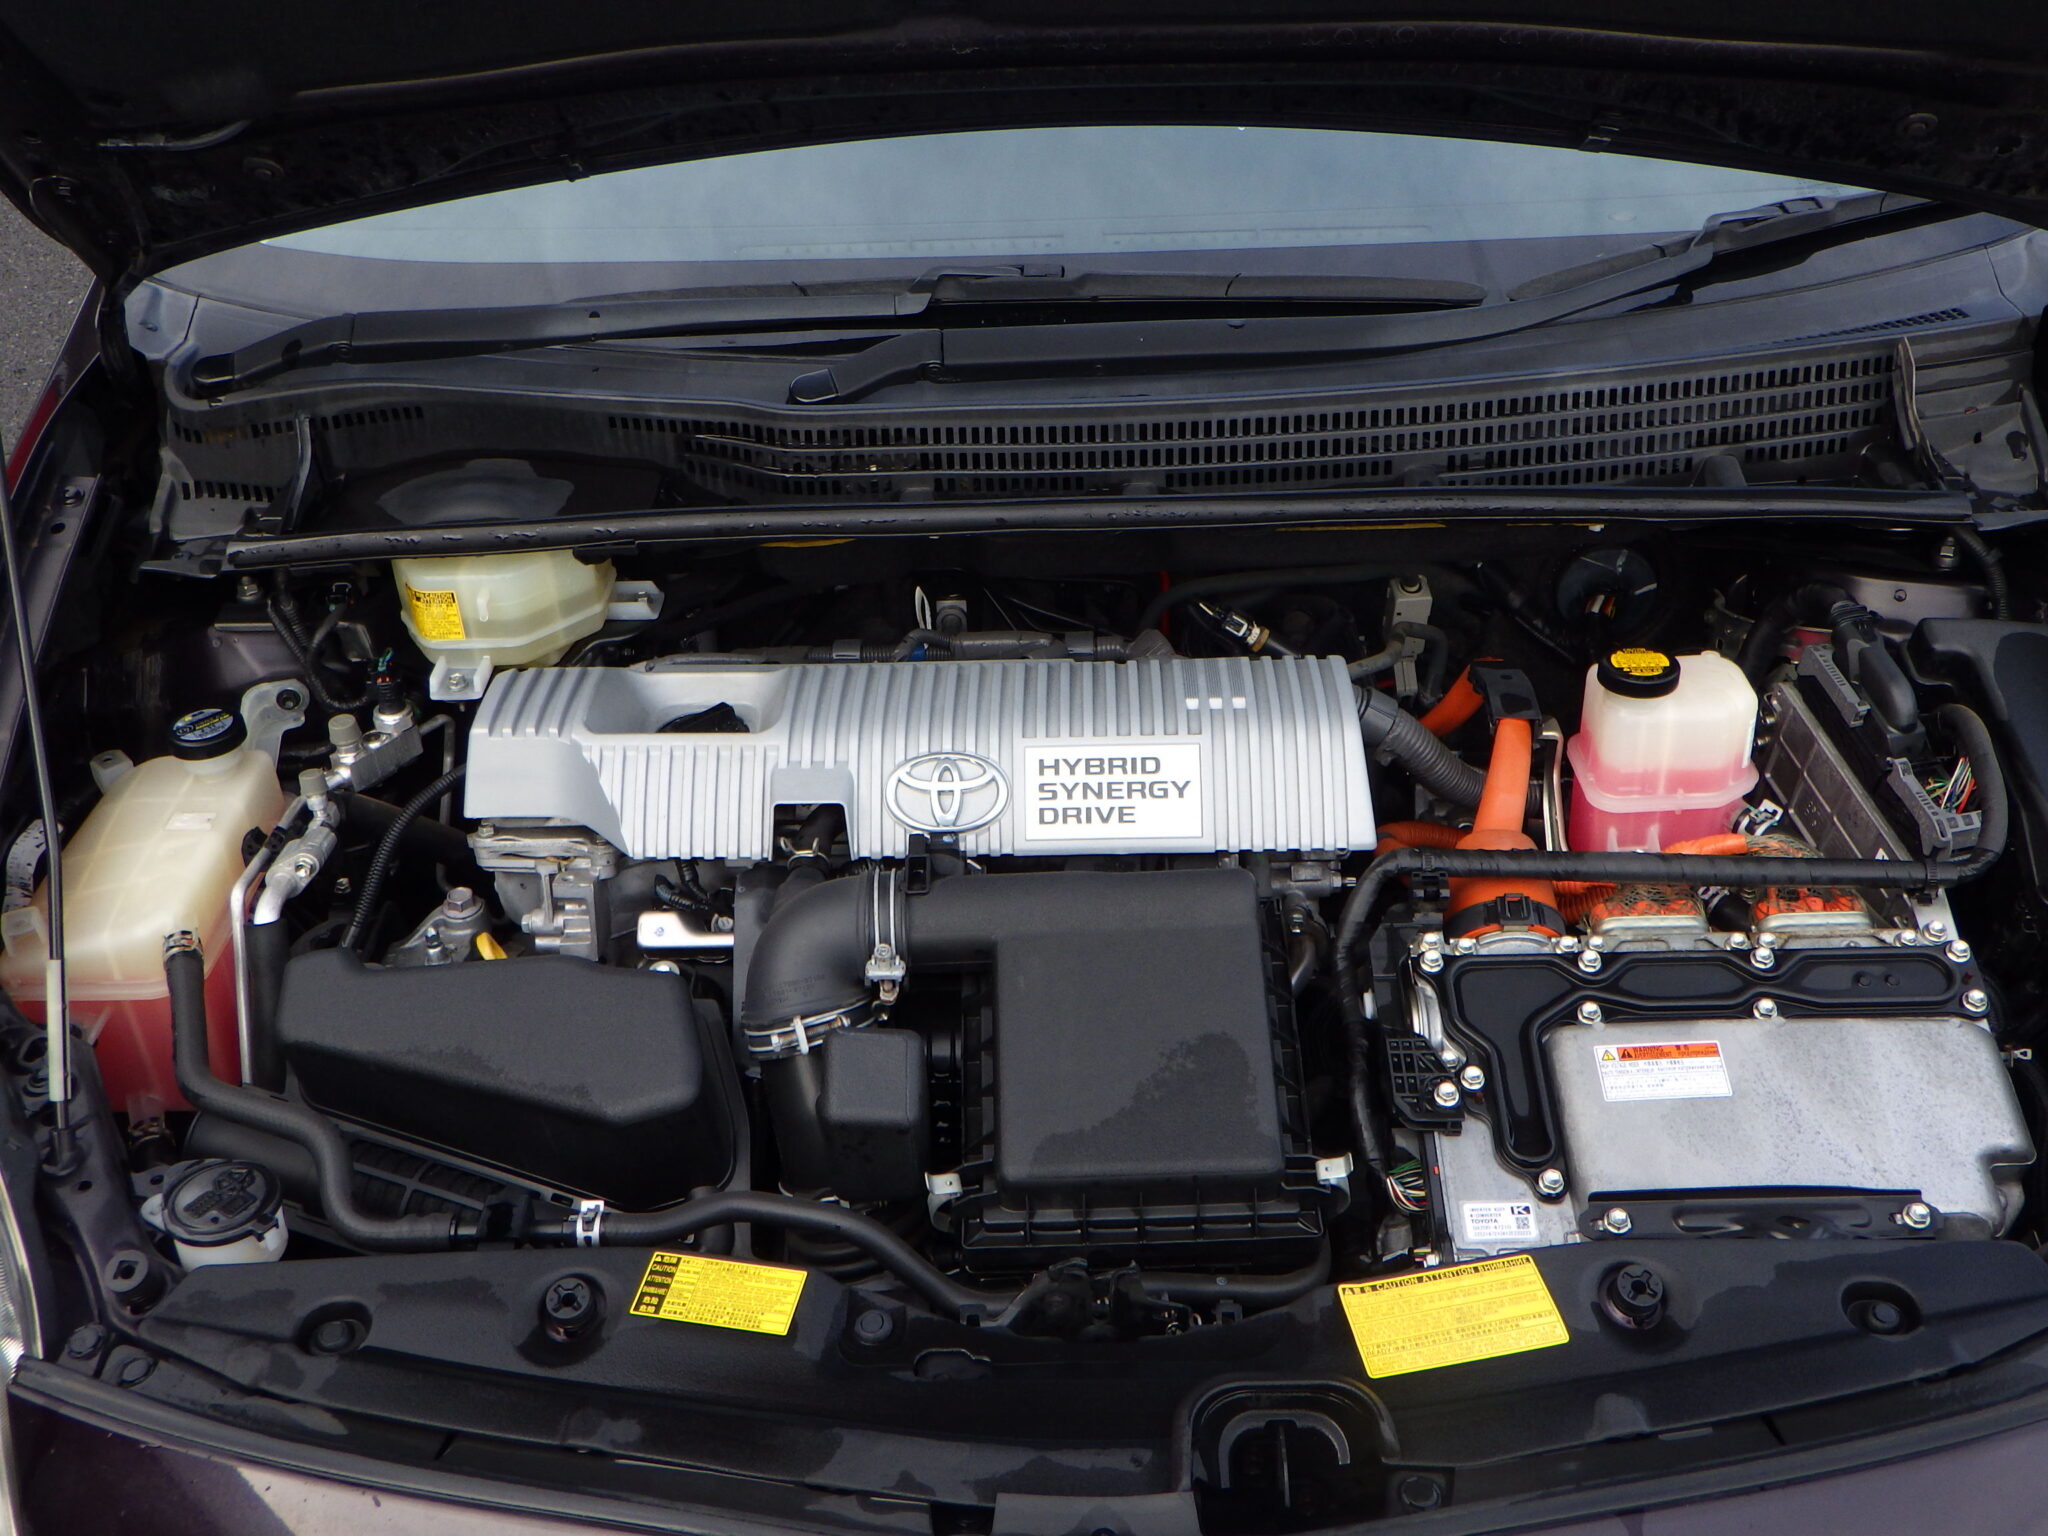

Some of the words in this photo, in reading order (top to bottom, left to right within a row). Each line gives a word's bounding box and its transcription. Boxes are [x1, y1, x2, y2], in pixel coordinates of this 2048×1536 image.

[1038, 756, 1161, 776] HYBRID
[1038, 780, 1191, 801] SYNERGY
[1038, 806, 1136, 825] DRIVE
[651, 1263, 678, 1273] CAUTION
[1377, 1277, 1418, 1291] CAUTION
[1422, 1267, 1475, 1283] ATTENTION
